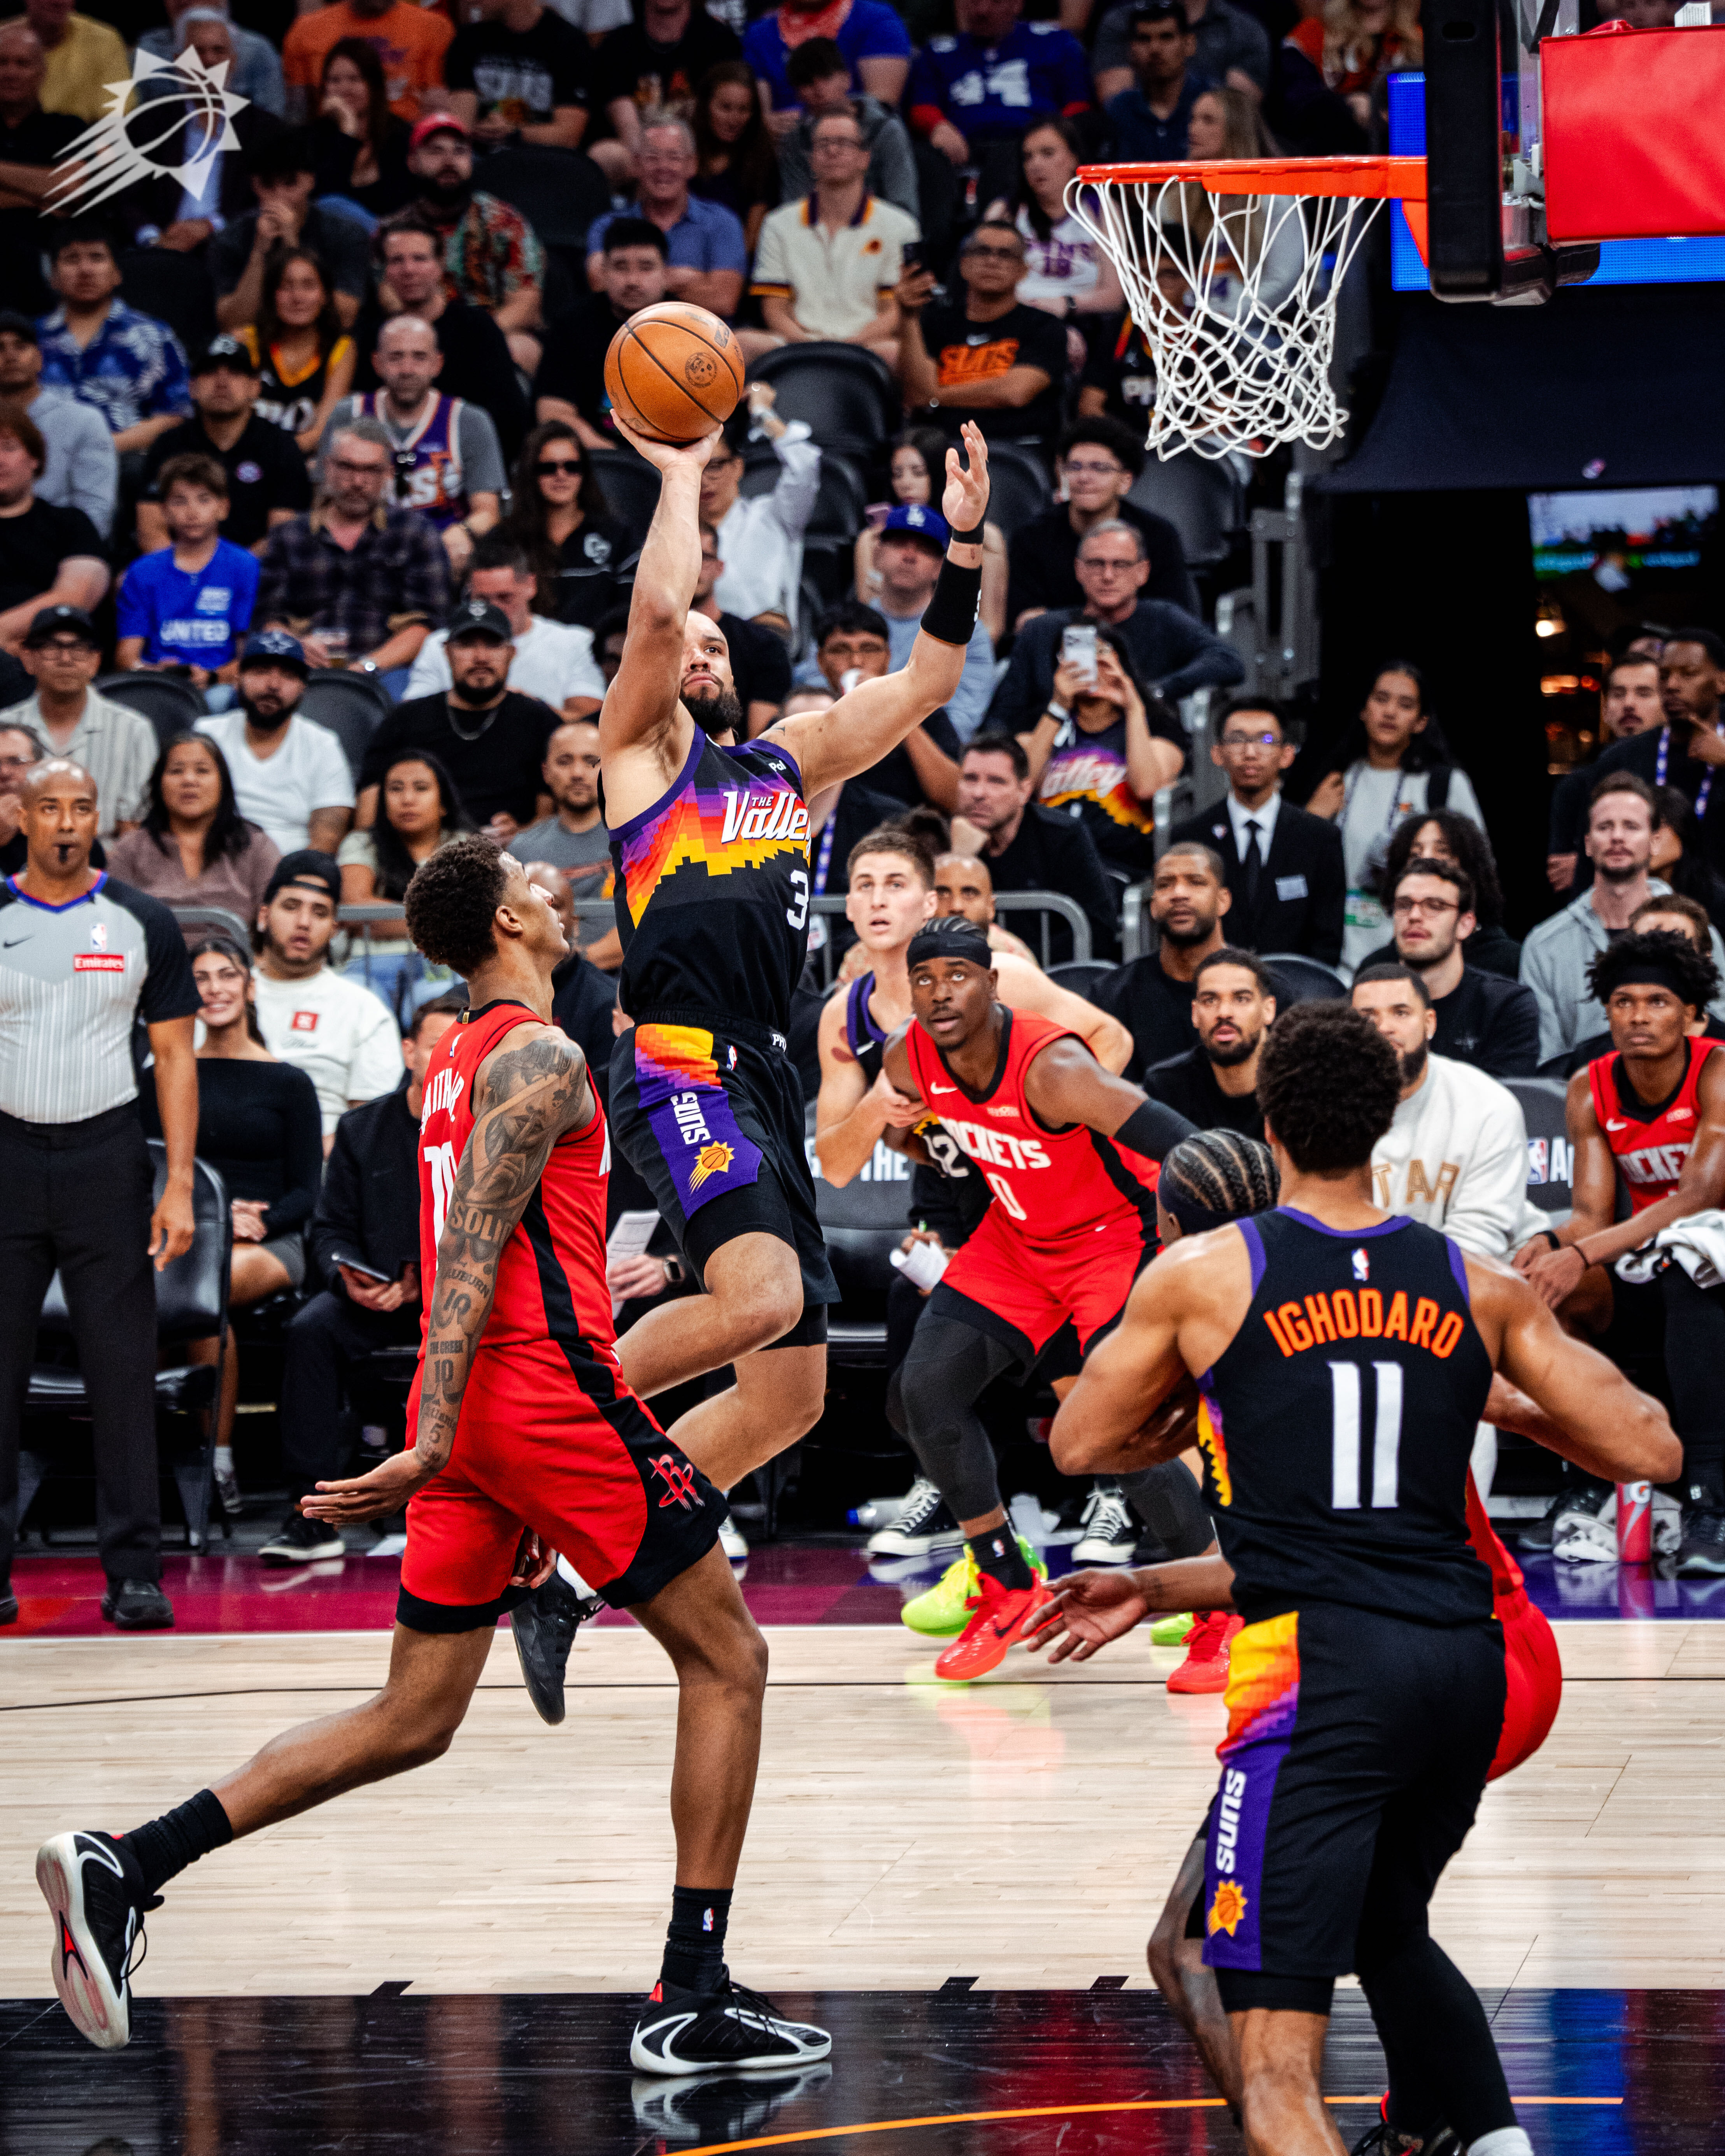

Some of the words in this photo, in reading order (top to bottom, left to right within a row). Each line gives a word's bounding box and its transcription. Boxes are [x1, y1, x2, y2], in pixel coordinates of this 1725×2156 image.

[751, 796, 774, 807] THE
[786, 869, 810, 931] 3
[74, 958, 123, 969] Emirates
[987, 1173, 1027, 1221] 0
[1263, 1288, 1465, 1359] IGHODARO
[434, 1358, 454, 1383] 10
[428, 1422, 445, 1444] 5
[1327, 1361, 1403, 1509] 11
